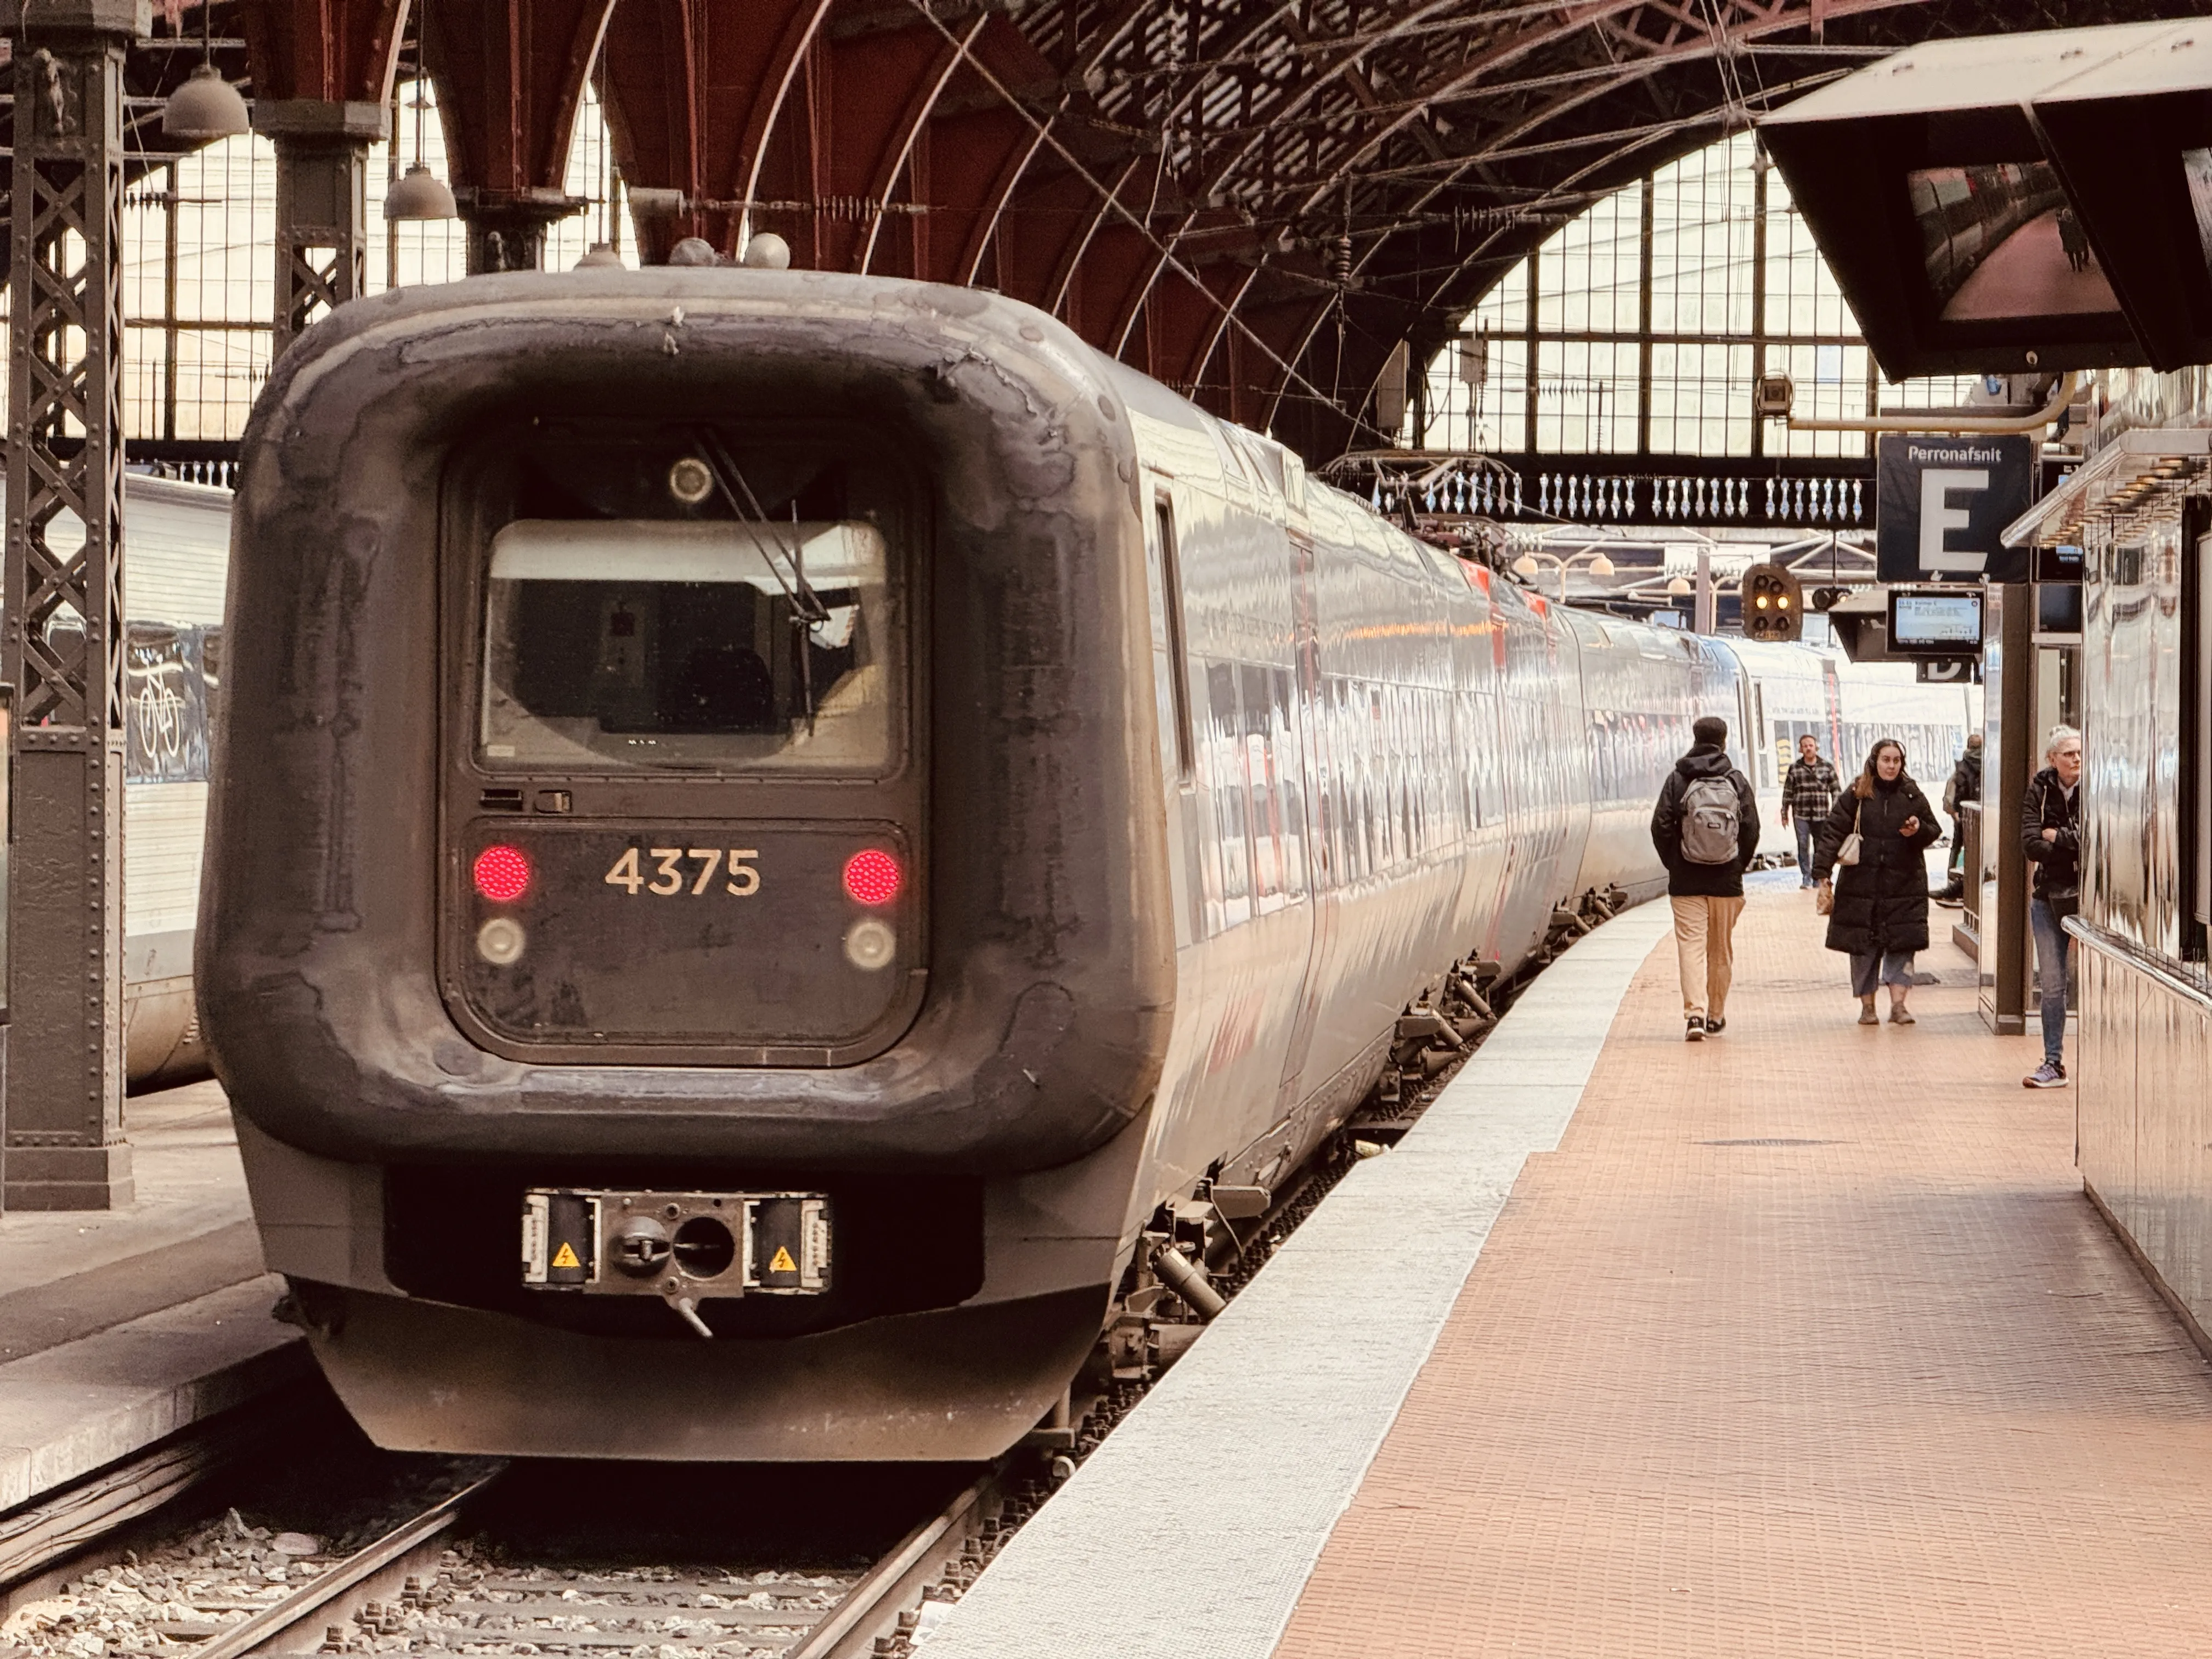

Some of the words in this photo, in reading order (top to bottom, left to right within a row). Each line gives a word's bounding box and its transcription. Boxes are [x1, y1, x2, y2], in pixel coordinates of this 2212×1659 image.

[1909, 445, 2002, 462] Perronafsnit
[1919, 469, 1989, 572] E
[605, 848, 761, 896] 4375
